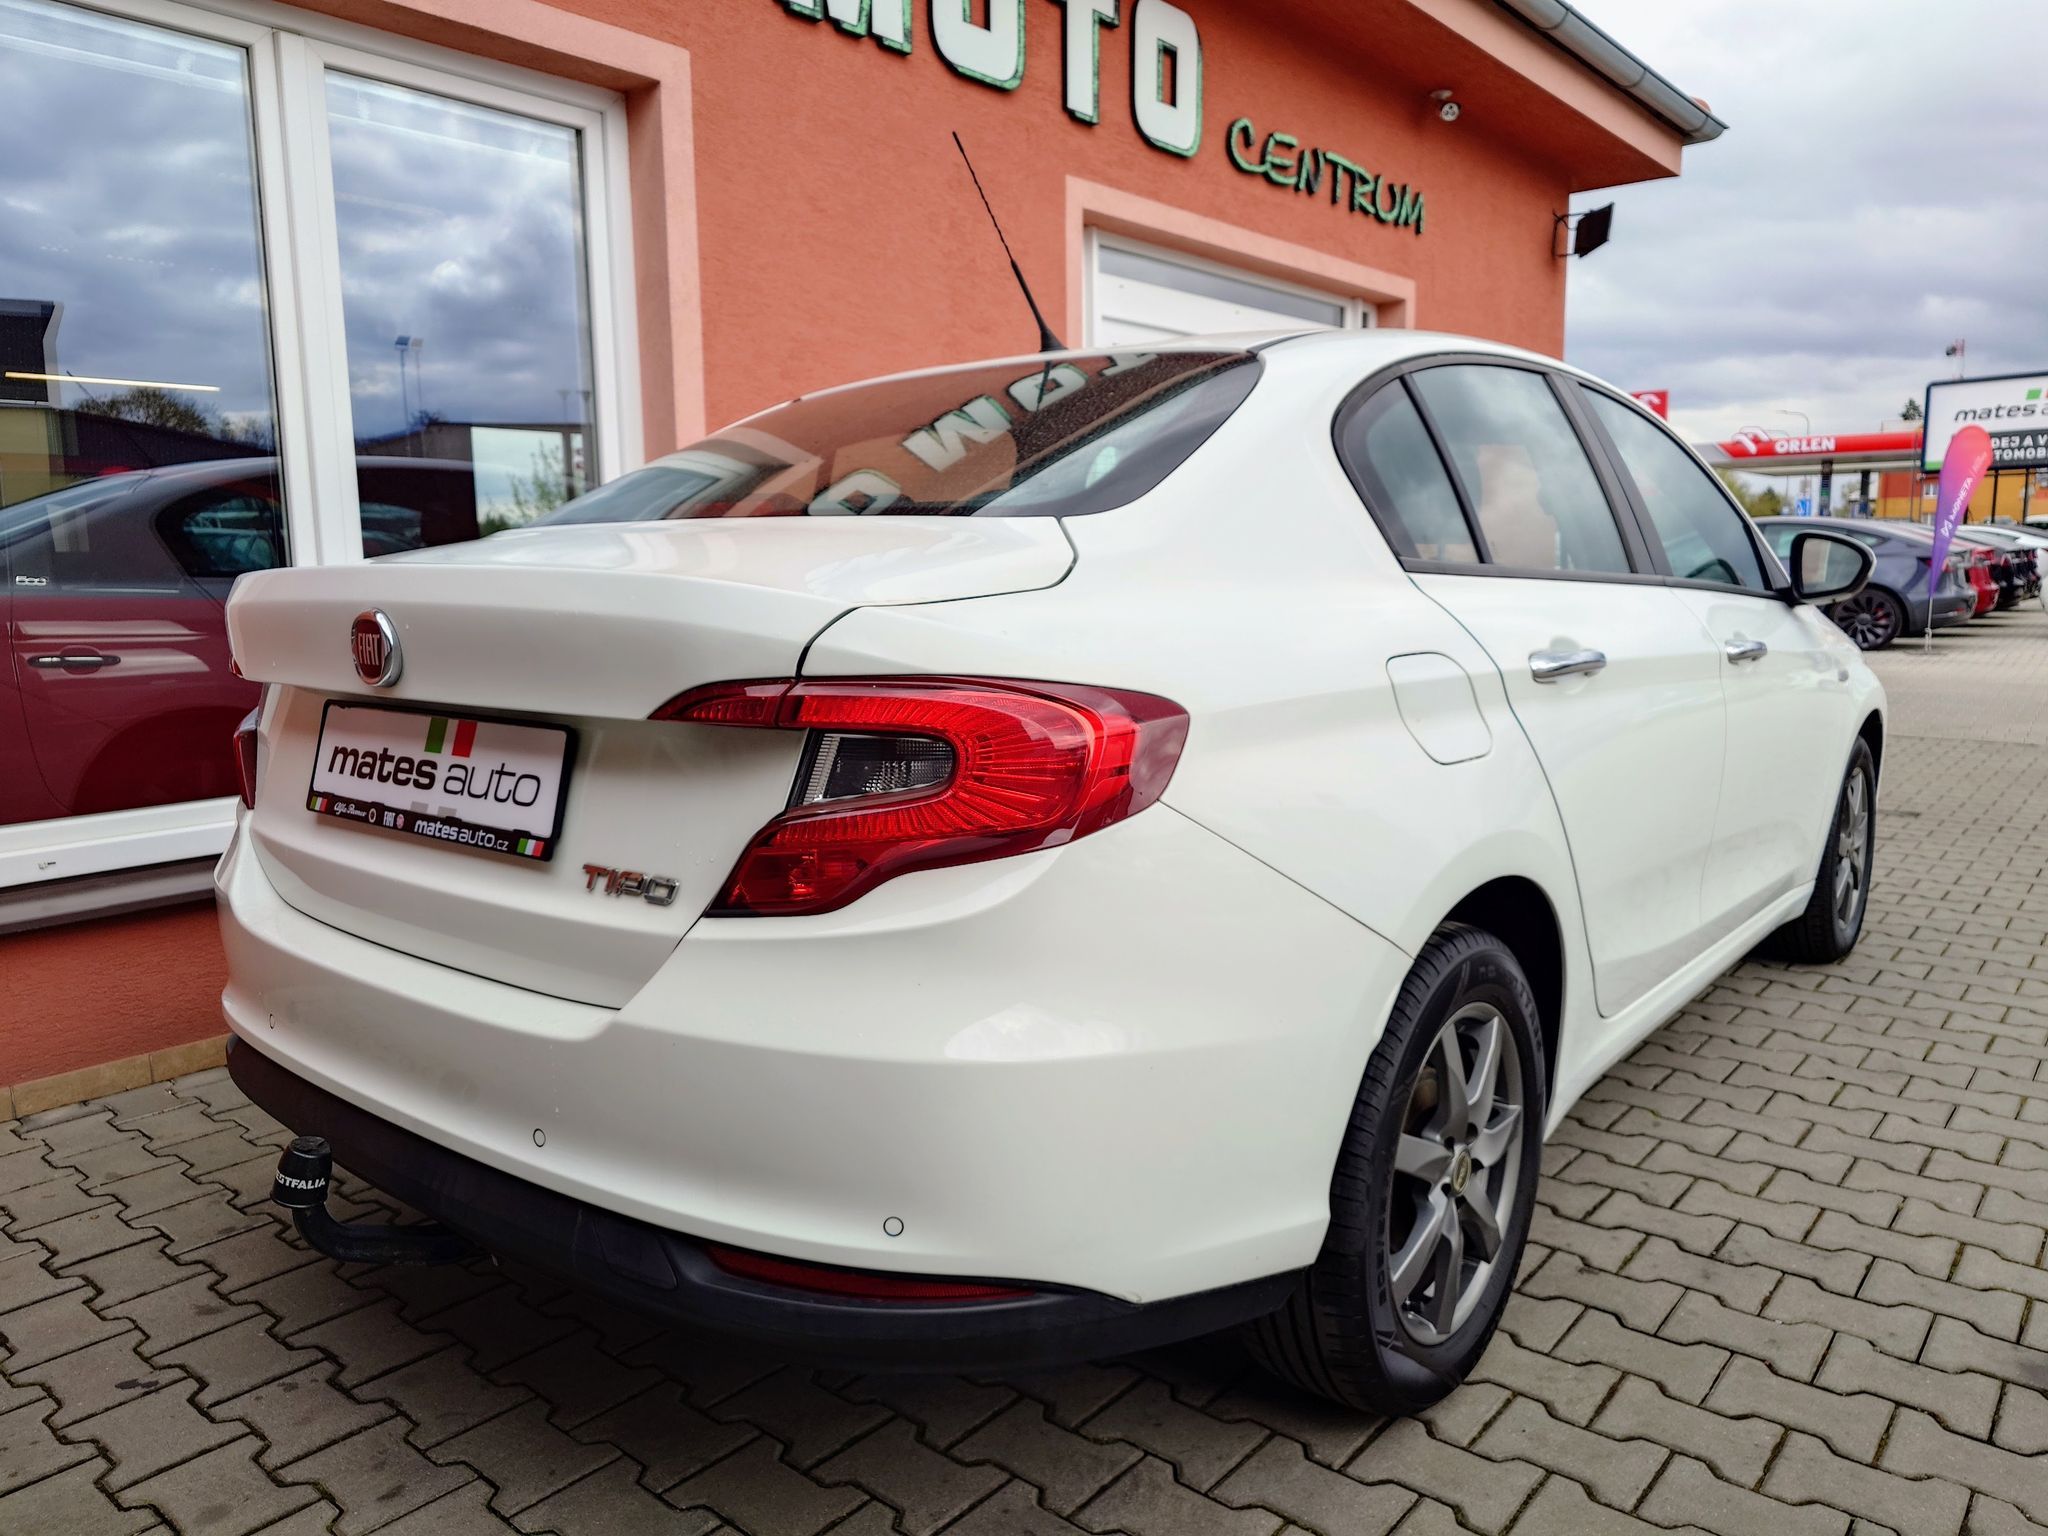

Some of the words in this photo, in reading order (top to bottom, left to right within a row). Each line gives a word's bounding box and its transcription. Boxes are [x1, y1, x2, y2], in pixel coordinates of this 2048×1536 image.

[773, 0, 1204, 159] OTO
[1226, 117, 1425, 236] CENTRUM
[1954, 402, 2038, 422] mates
[1774, 437, 1836, 454] ORLEN
[1994, 446, 2048, 461] TOMOB
[357, 632, 380, 666] FIAT
[328, 745, 438, 790] mates
[443, 763, 541, 807] auto
[582, 863, 681, 907] TIPO
